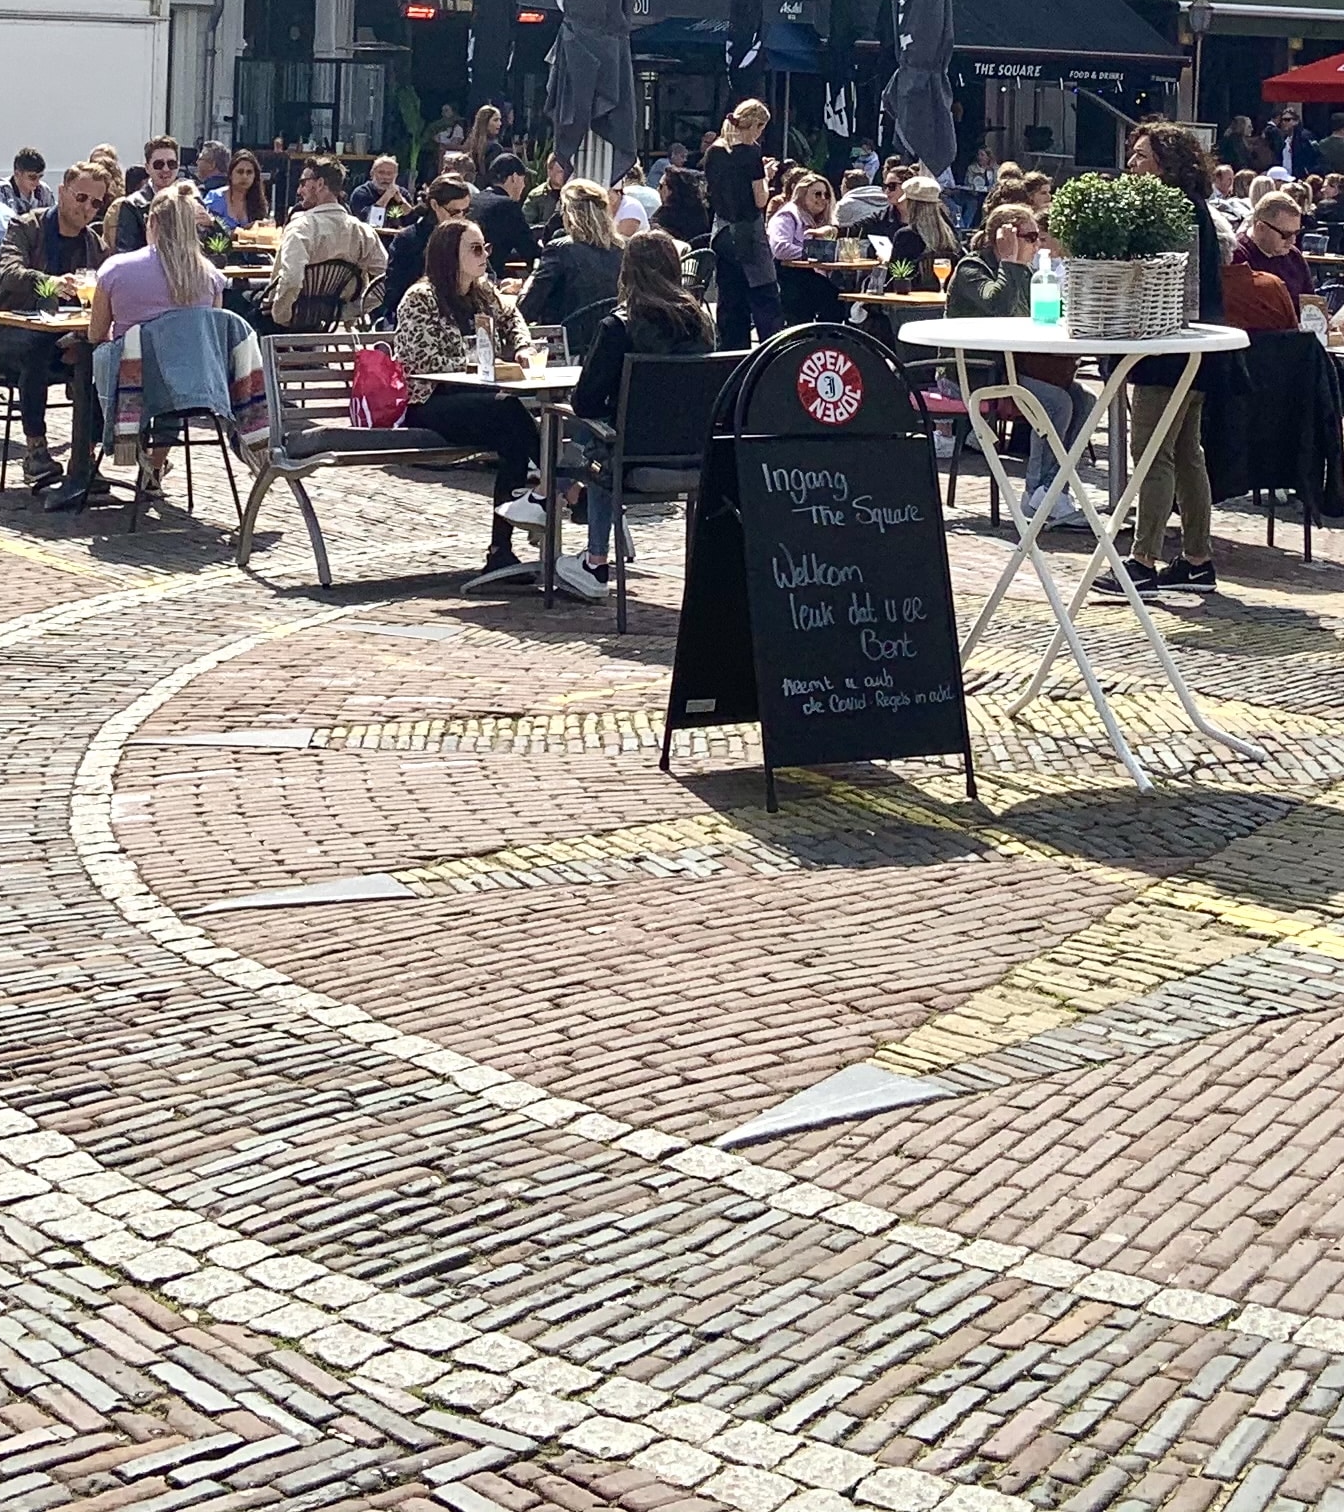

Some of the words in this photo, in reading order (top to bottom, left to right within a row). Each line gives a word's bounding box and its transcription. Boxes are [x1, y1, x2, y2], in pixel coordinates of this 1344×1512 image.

[974, 62, 995, 76] THE
[998, 63, 1042, 77] SQUARE
[1069, 70, 1090, 79] FOOD
[1090, 70, 1098, 79] &
[799, 350, 852, 388] JOPEN
[808, 385, 861, 422] JOPEN
[762, 463, 849, 504] Ingang
[792, 505, 845, 526] The
[852, 495, 924, 534] Square
[772, 542, 863, 589] Welkom
[789, 592, 835, 631] leuk
[848, 592, 878, 625] dat
[860, 628, 917, 661] Bent
[864, 668, 894, 688] aub
[803, 697, 824, 715] de
[915, 692, 926, 704] in
